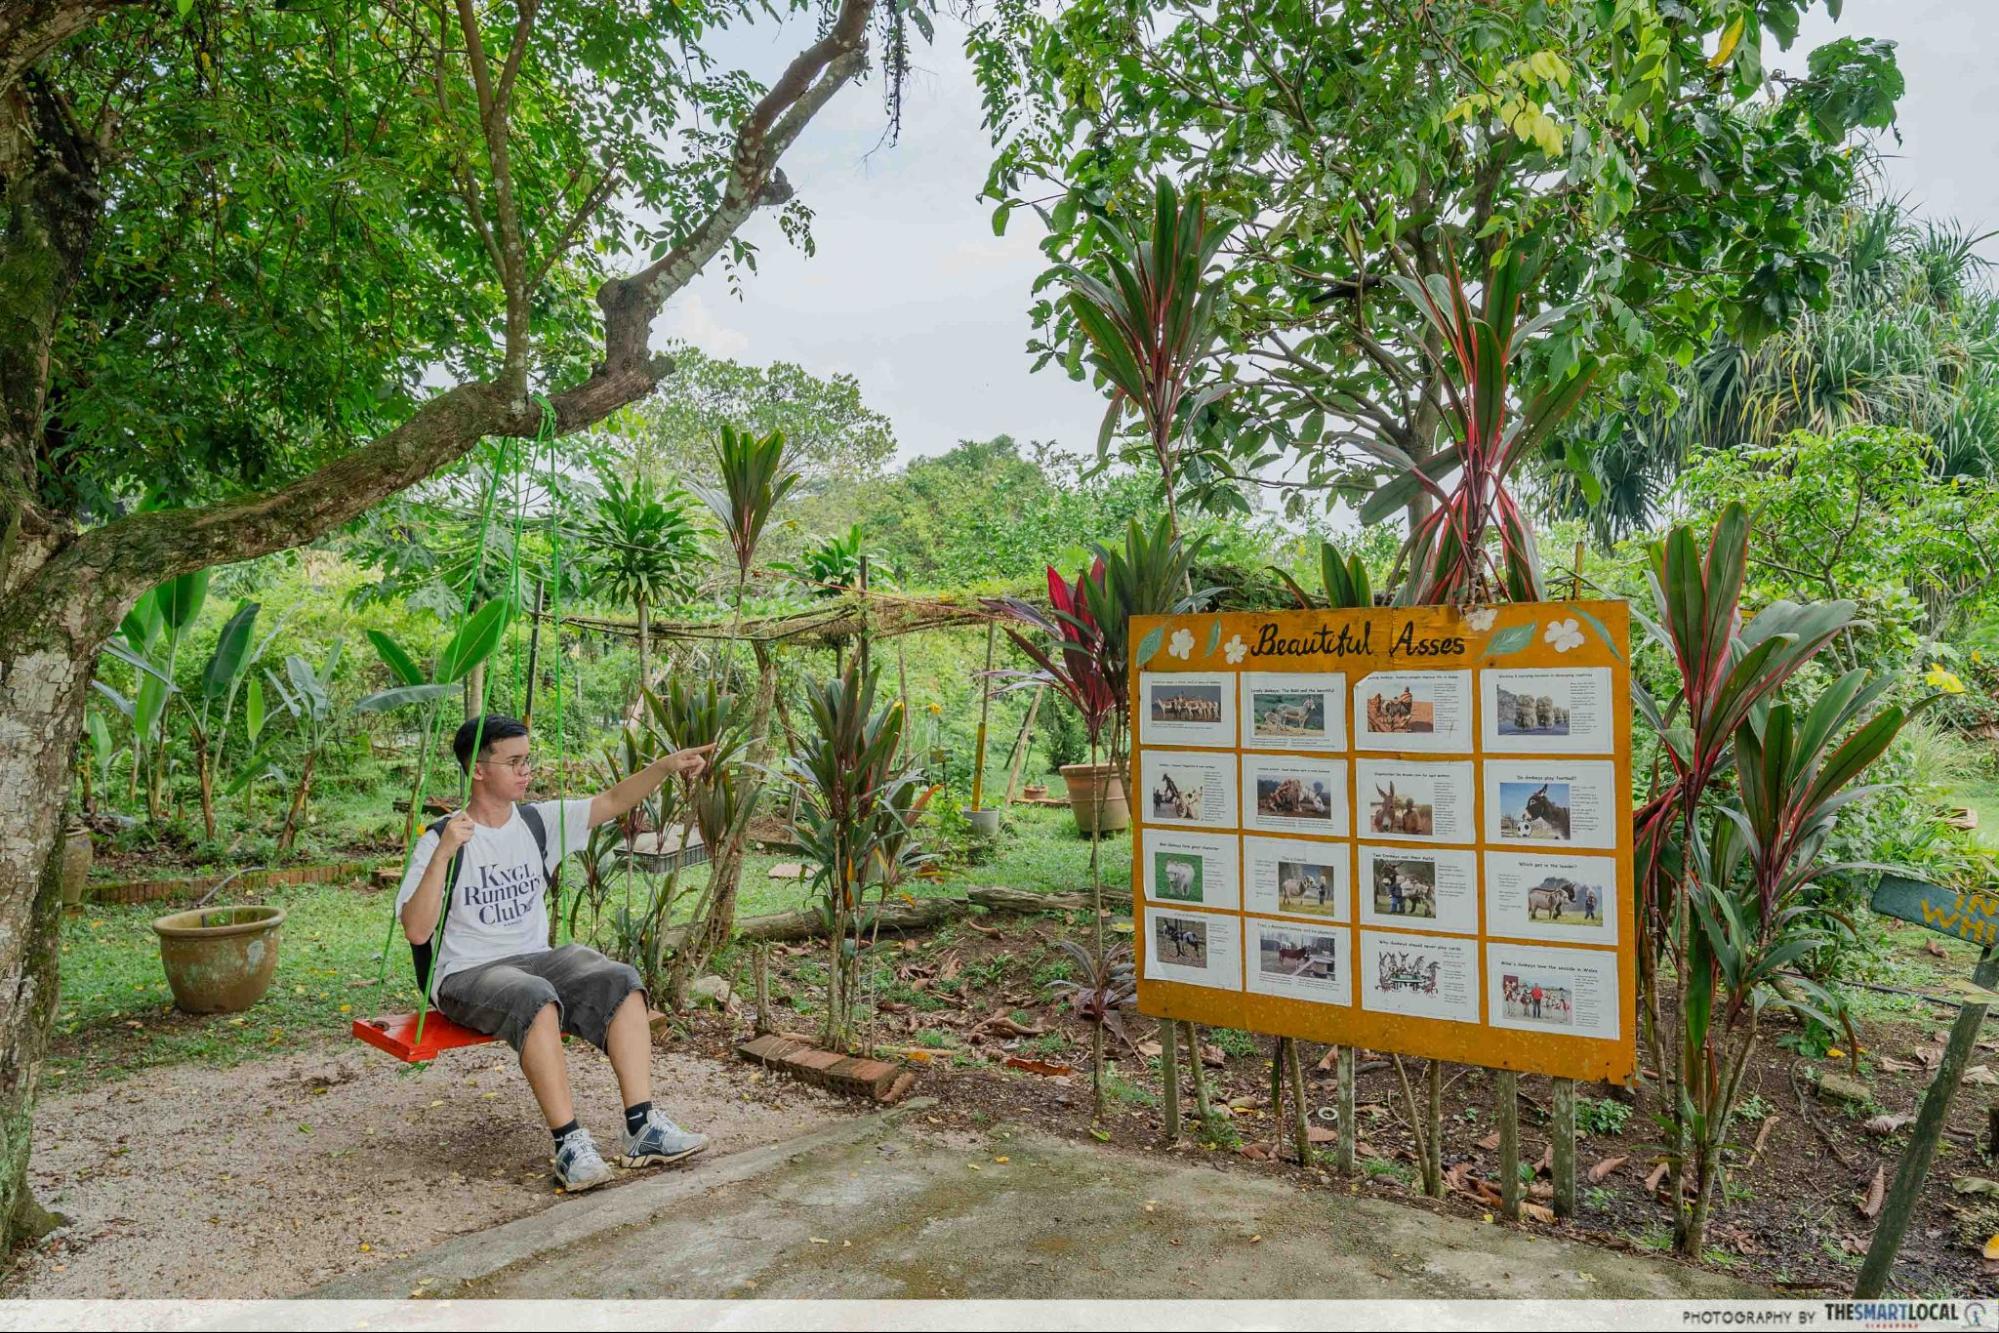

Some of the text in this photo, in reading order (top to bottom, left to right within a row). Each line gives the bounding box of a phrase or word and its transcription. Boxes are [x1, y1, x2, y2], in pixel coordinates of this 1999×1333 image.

[1251, 620, 1466, 657] Beautiful Asses
[479, 898, 527, 925] Club
